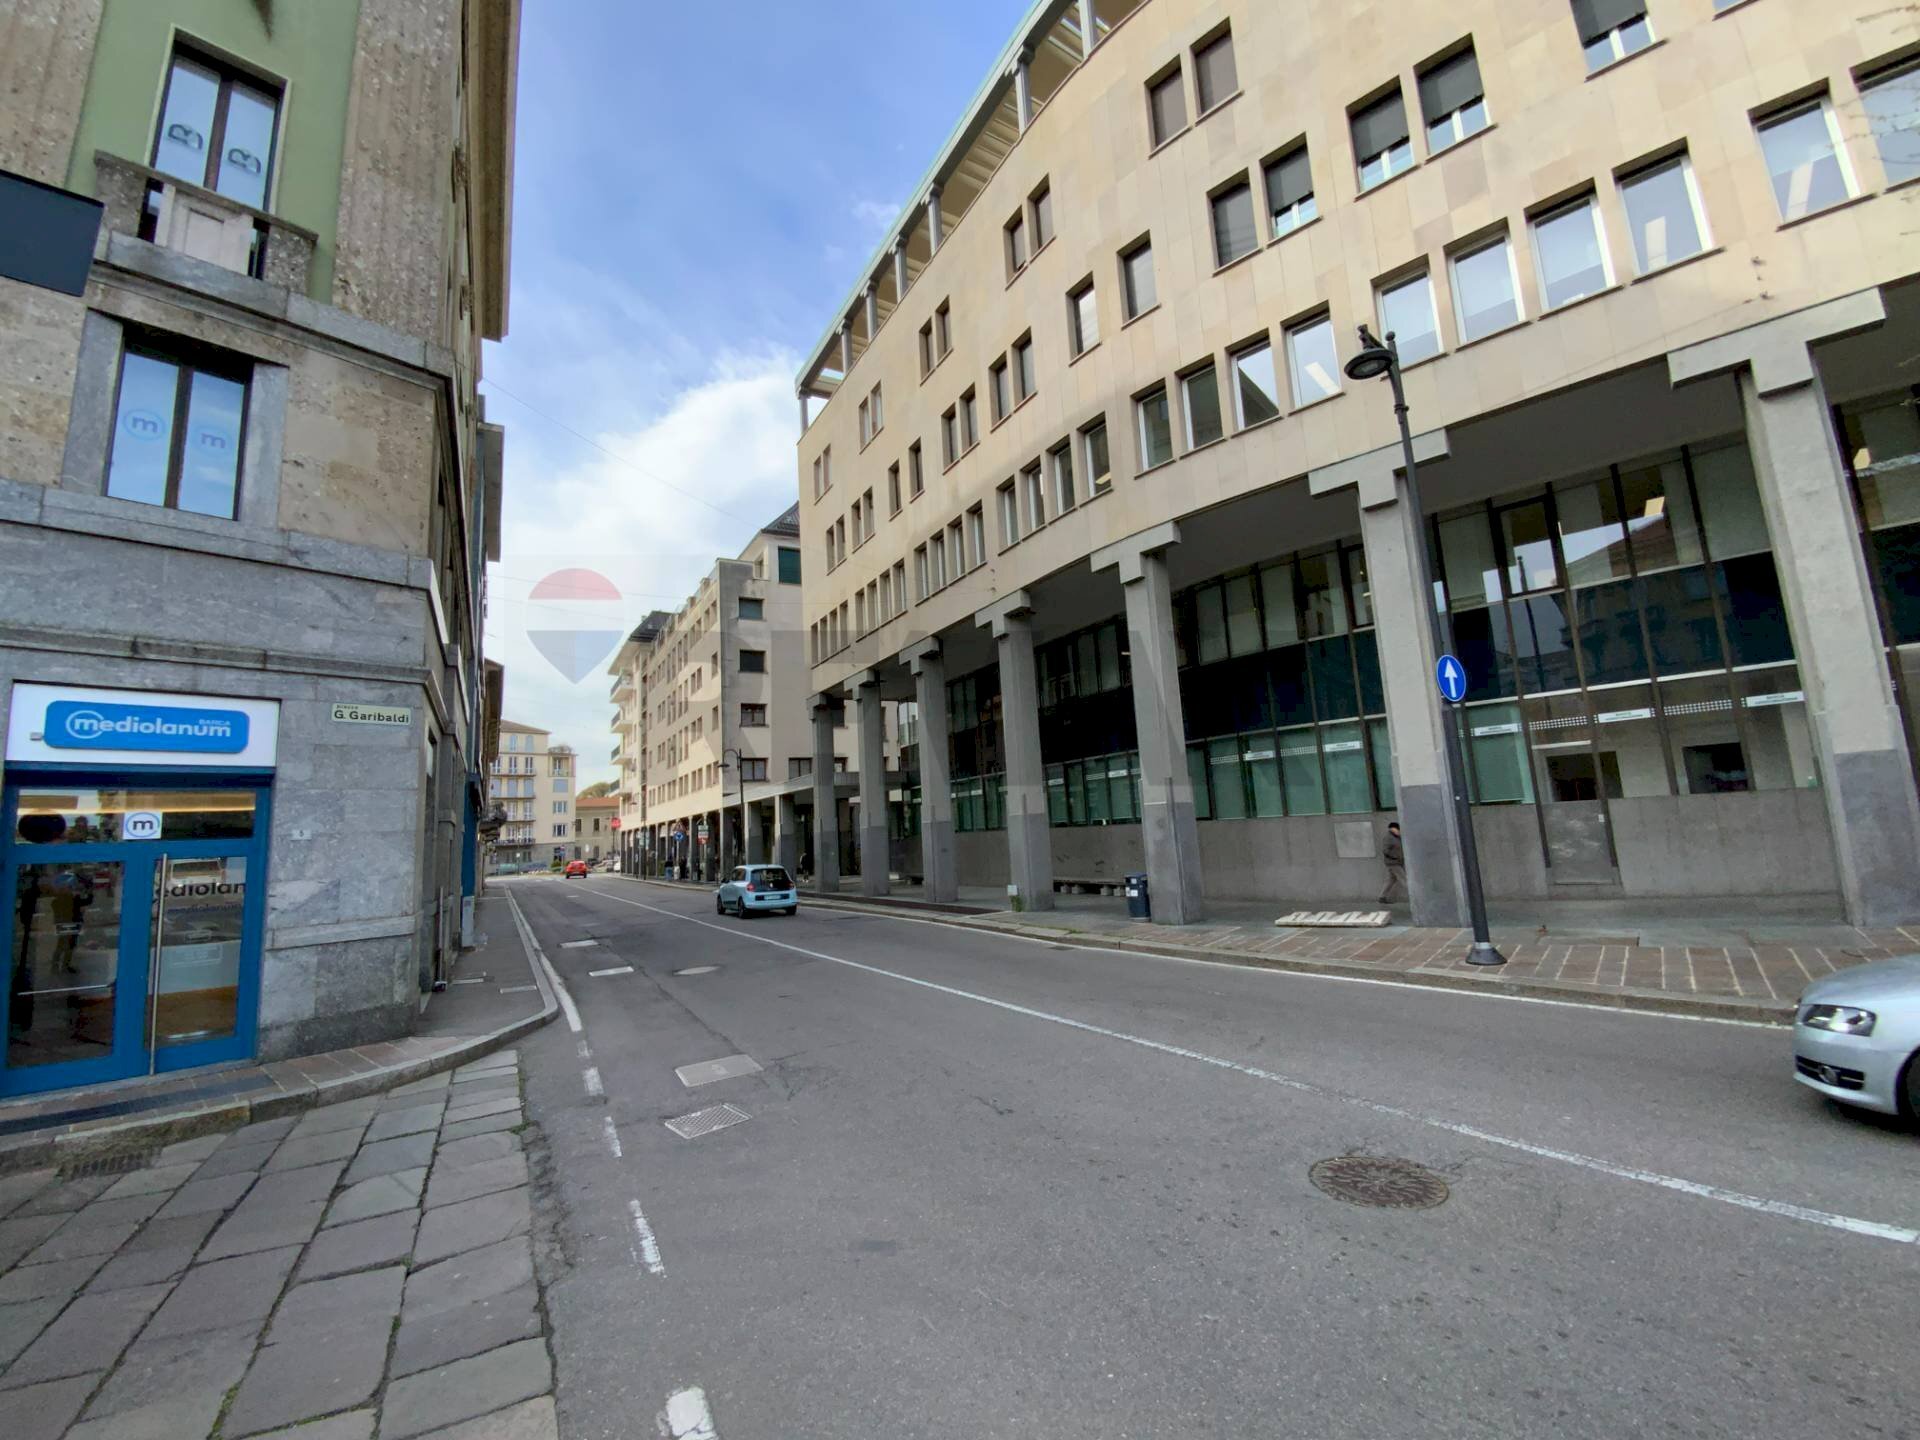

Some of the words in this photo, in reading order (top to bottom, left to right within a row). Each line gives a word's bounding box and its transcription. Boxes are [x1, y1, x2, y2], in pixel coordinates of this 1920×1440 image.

[334, 710, 346, 719] G.
[349, 711, 409, 723] Garibaldi
[73, 715, 231, 738] mediolanum
[133, 819, 153, 831] m
